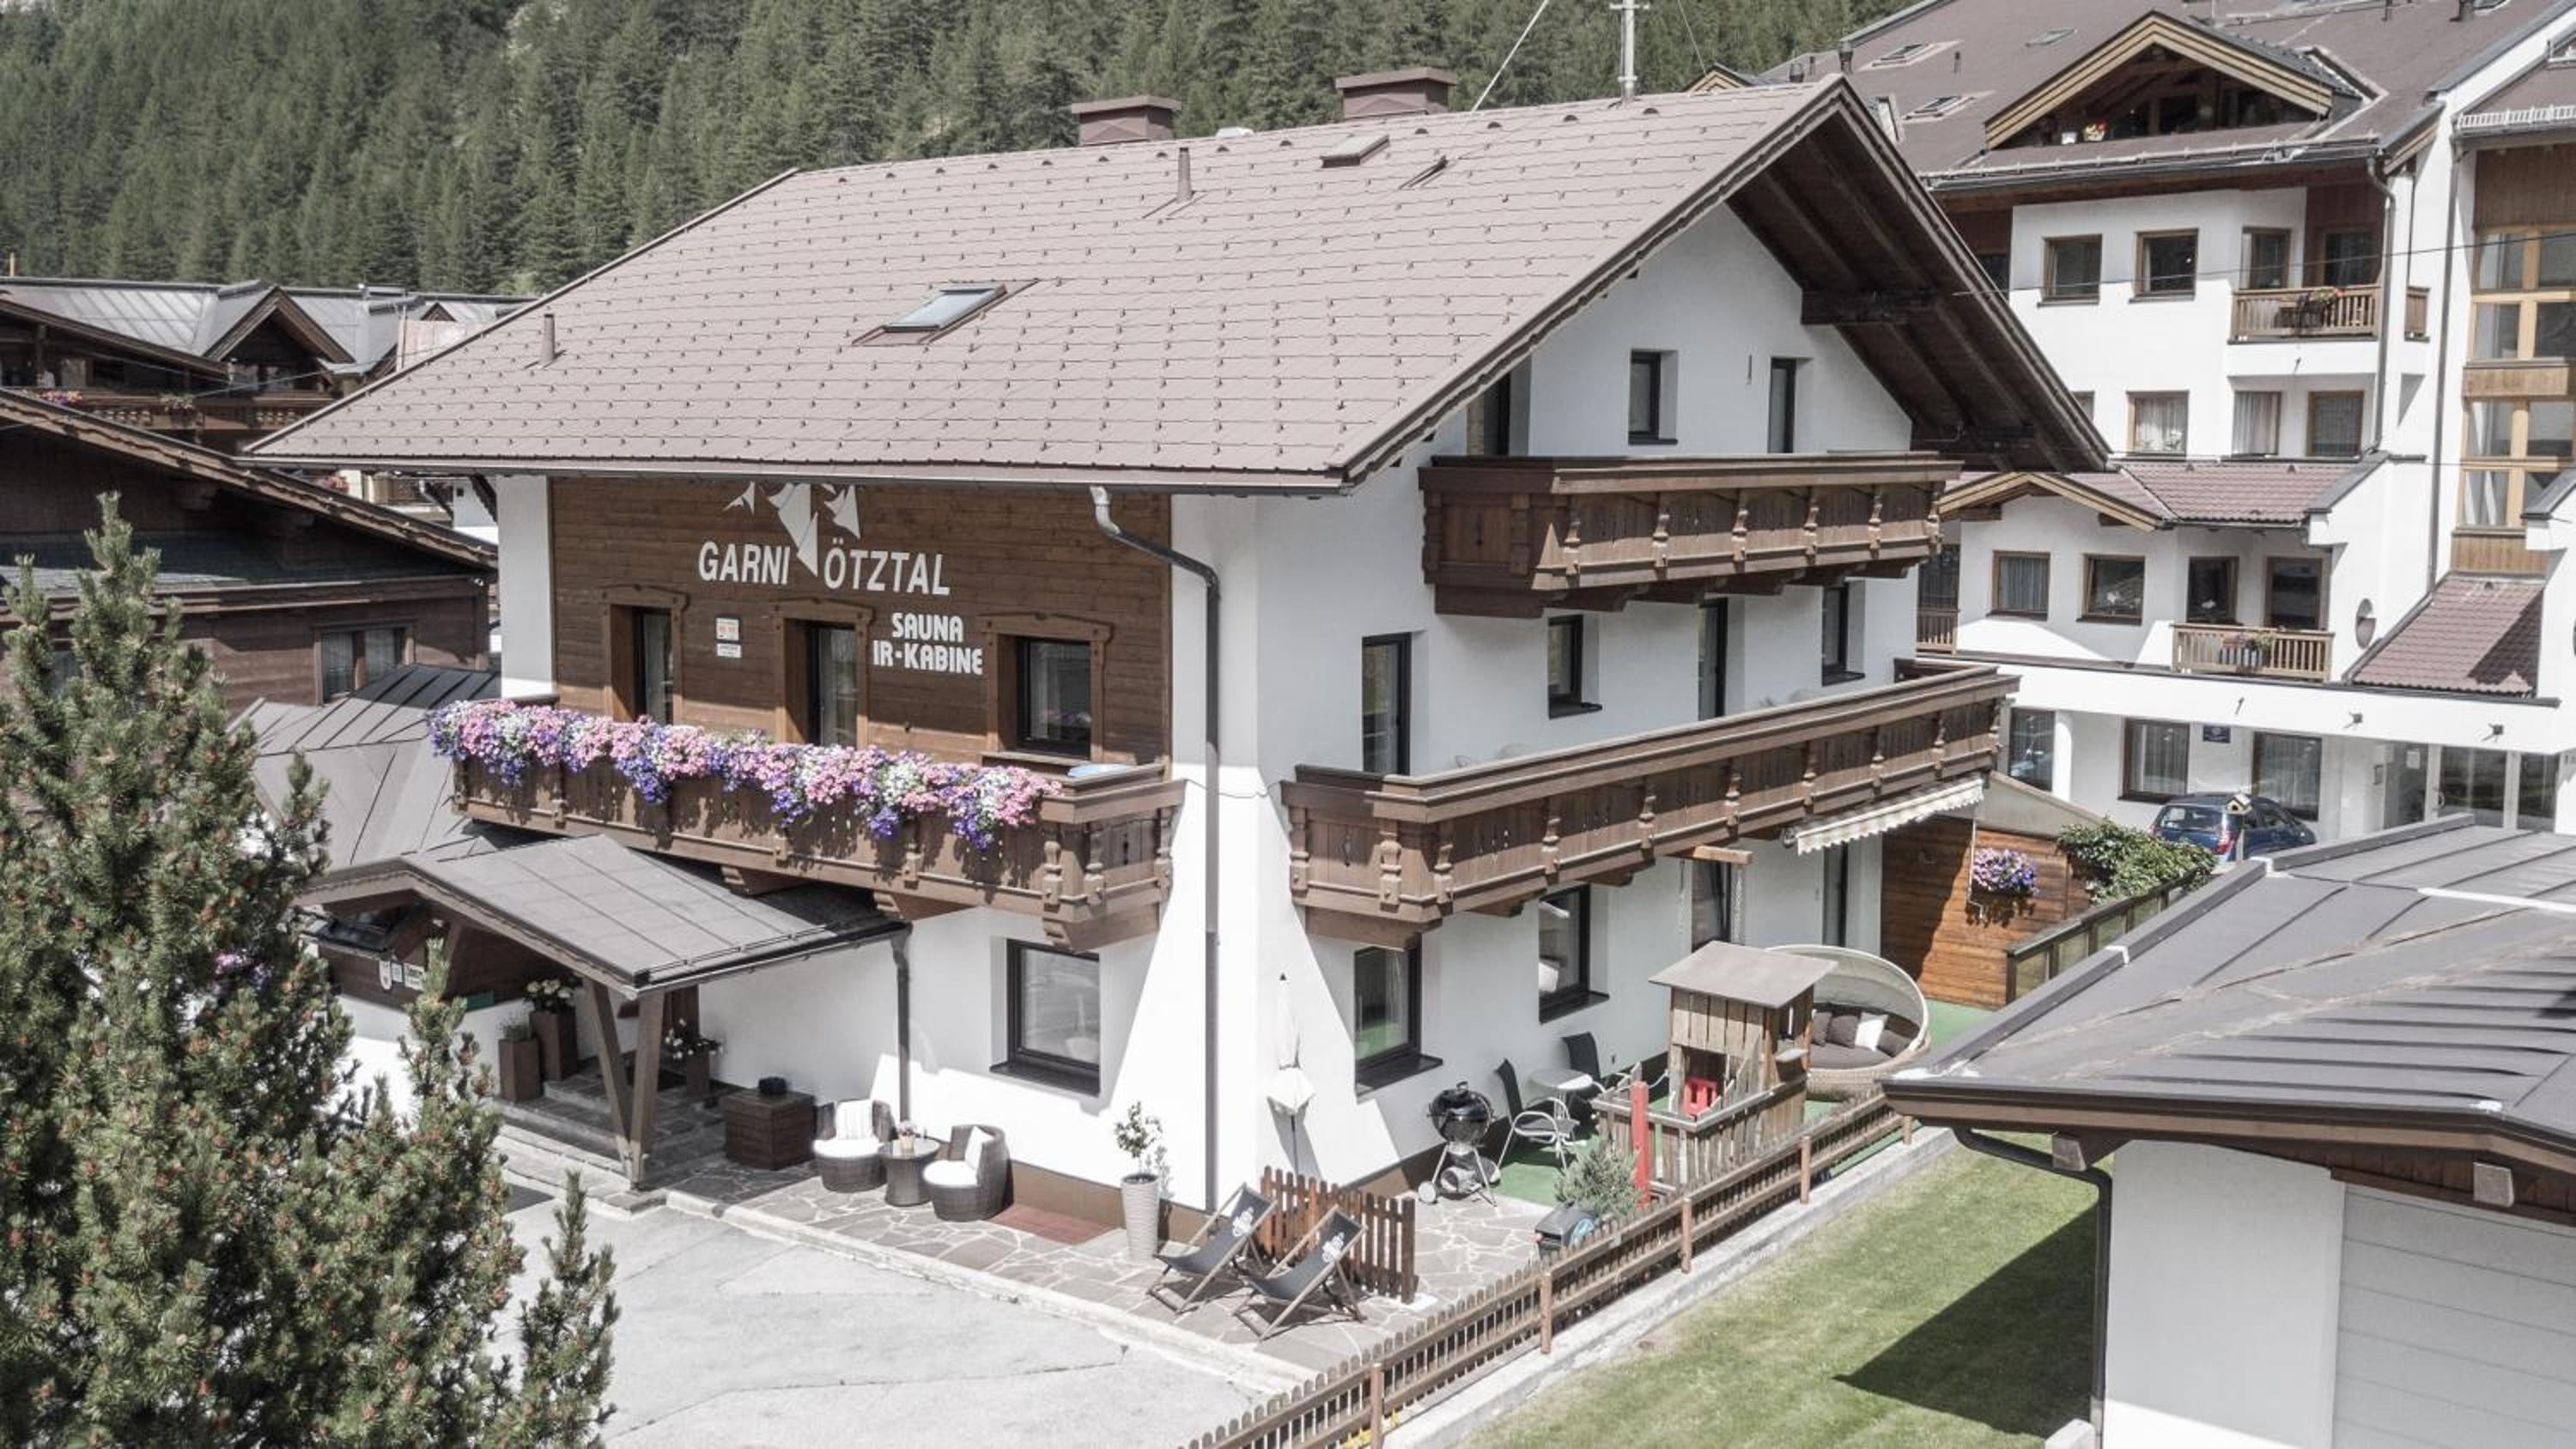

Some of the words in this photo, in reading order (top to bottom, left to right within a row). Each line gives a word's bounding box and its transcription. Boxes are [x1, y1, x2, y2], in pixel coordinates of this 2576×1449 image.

[698, 541, 791, 585] GARNI
[824, 538, 951, 596] ÖTZTAL
[891, 612, 964, 642] SAUNA
[873, 640, 983, 676] IR-KABINE
